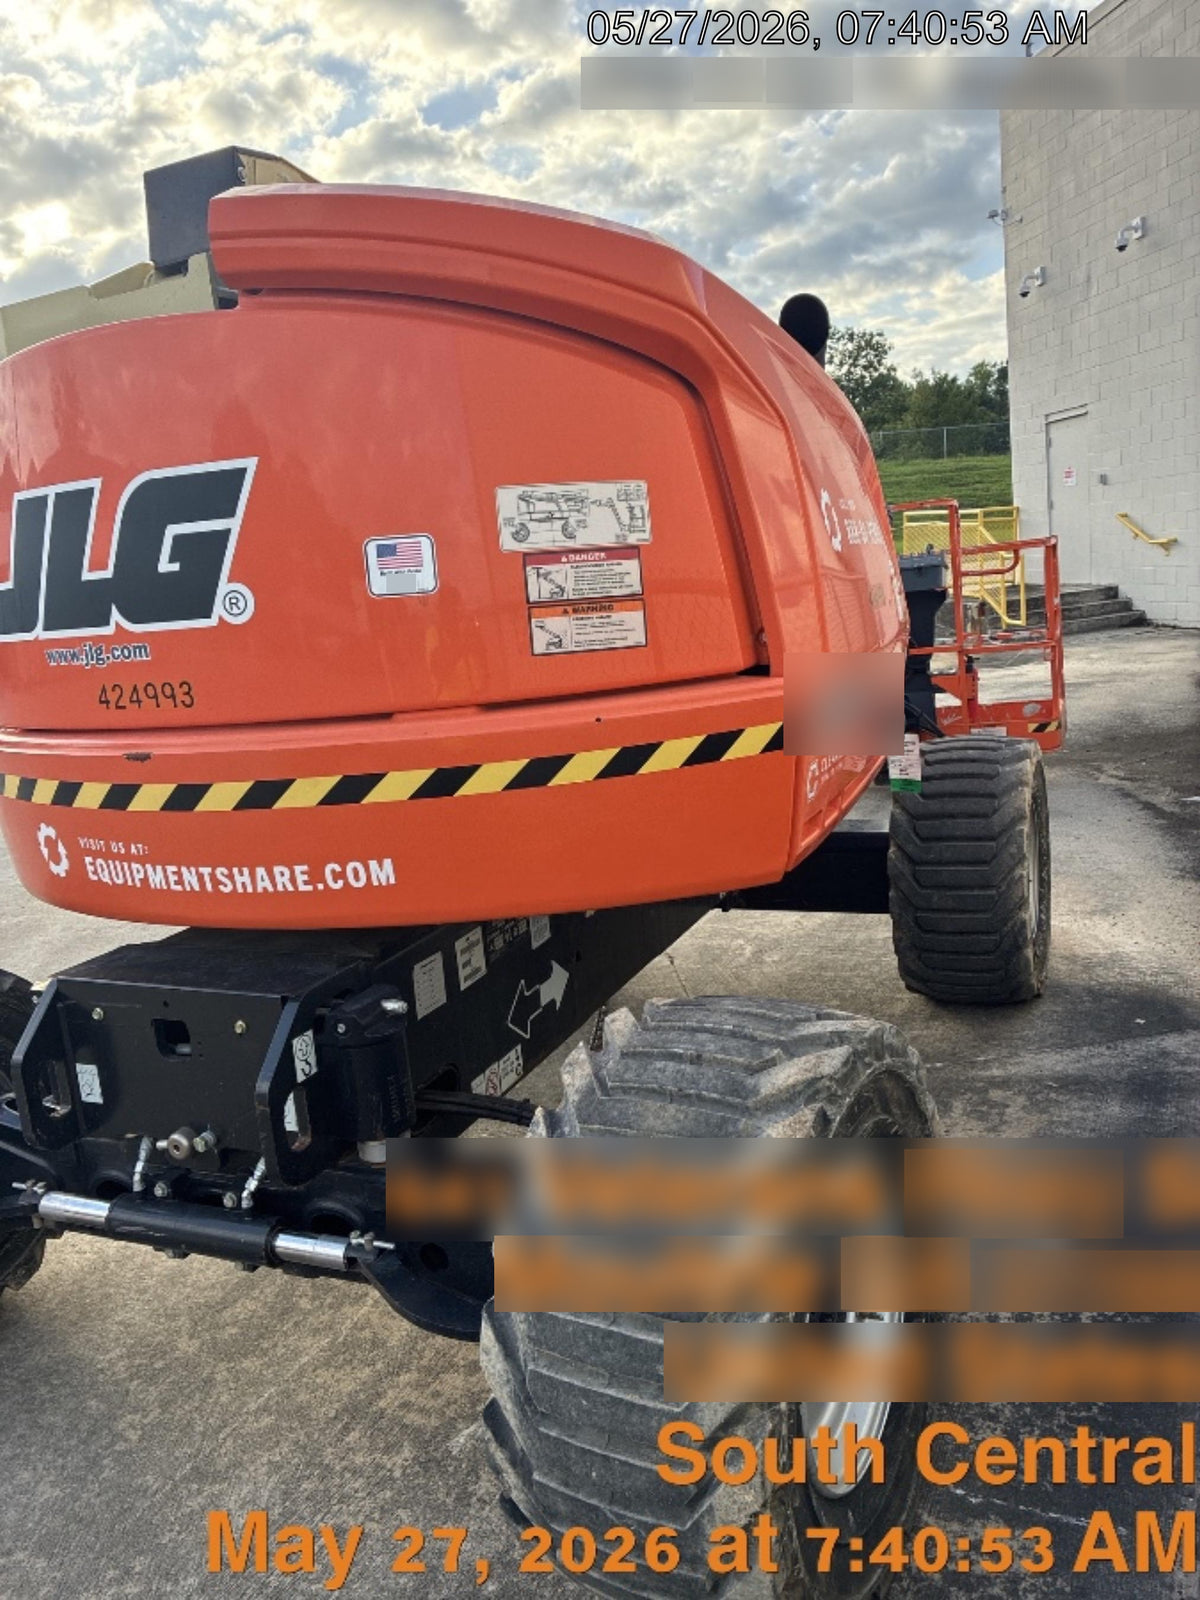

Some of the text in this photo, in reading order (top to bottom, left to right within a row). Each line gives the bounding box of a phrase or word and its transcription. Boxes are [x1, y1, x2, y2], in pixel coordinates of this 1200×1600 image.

[568, 552, 607, 562] DANGER
[572, 603, 614, 613] WARNING
[45, 642, 151, 669] www.jlg.com
[98, 680, 195, 710] 424993
[77, 837, 149, 856] VISIT US AT:
[83, 855, 397, 894] EQUIPMENTSHARE.COM
